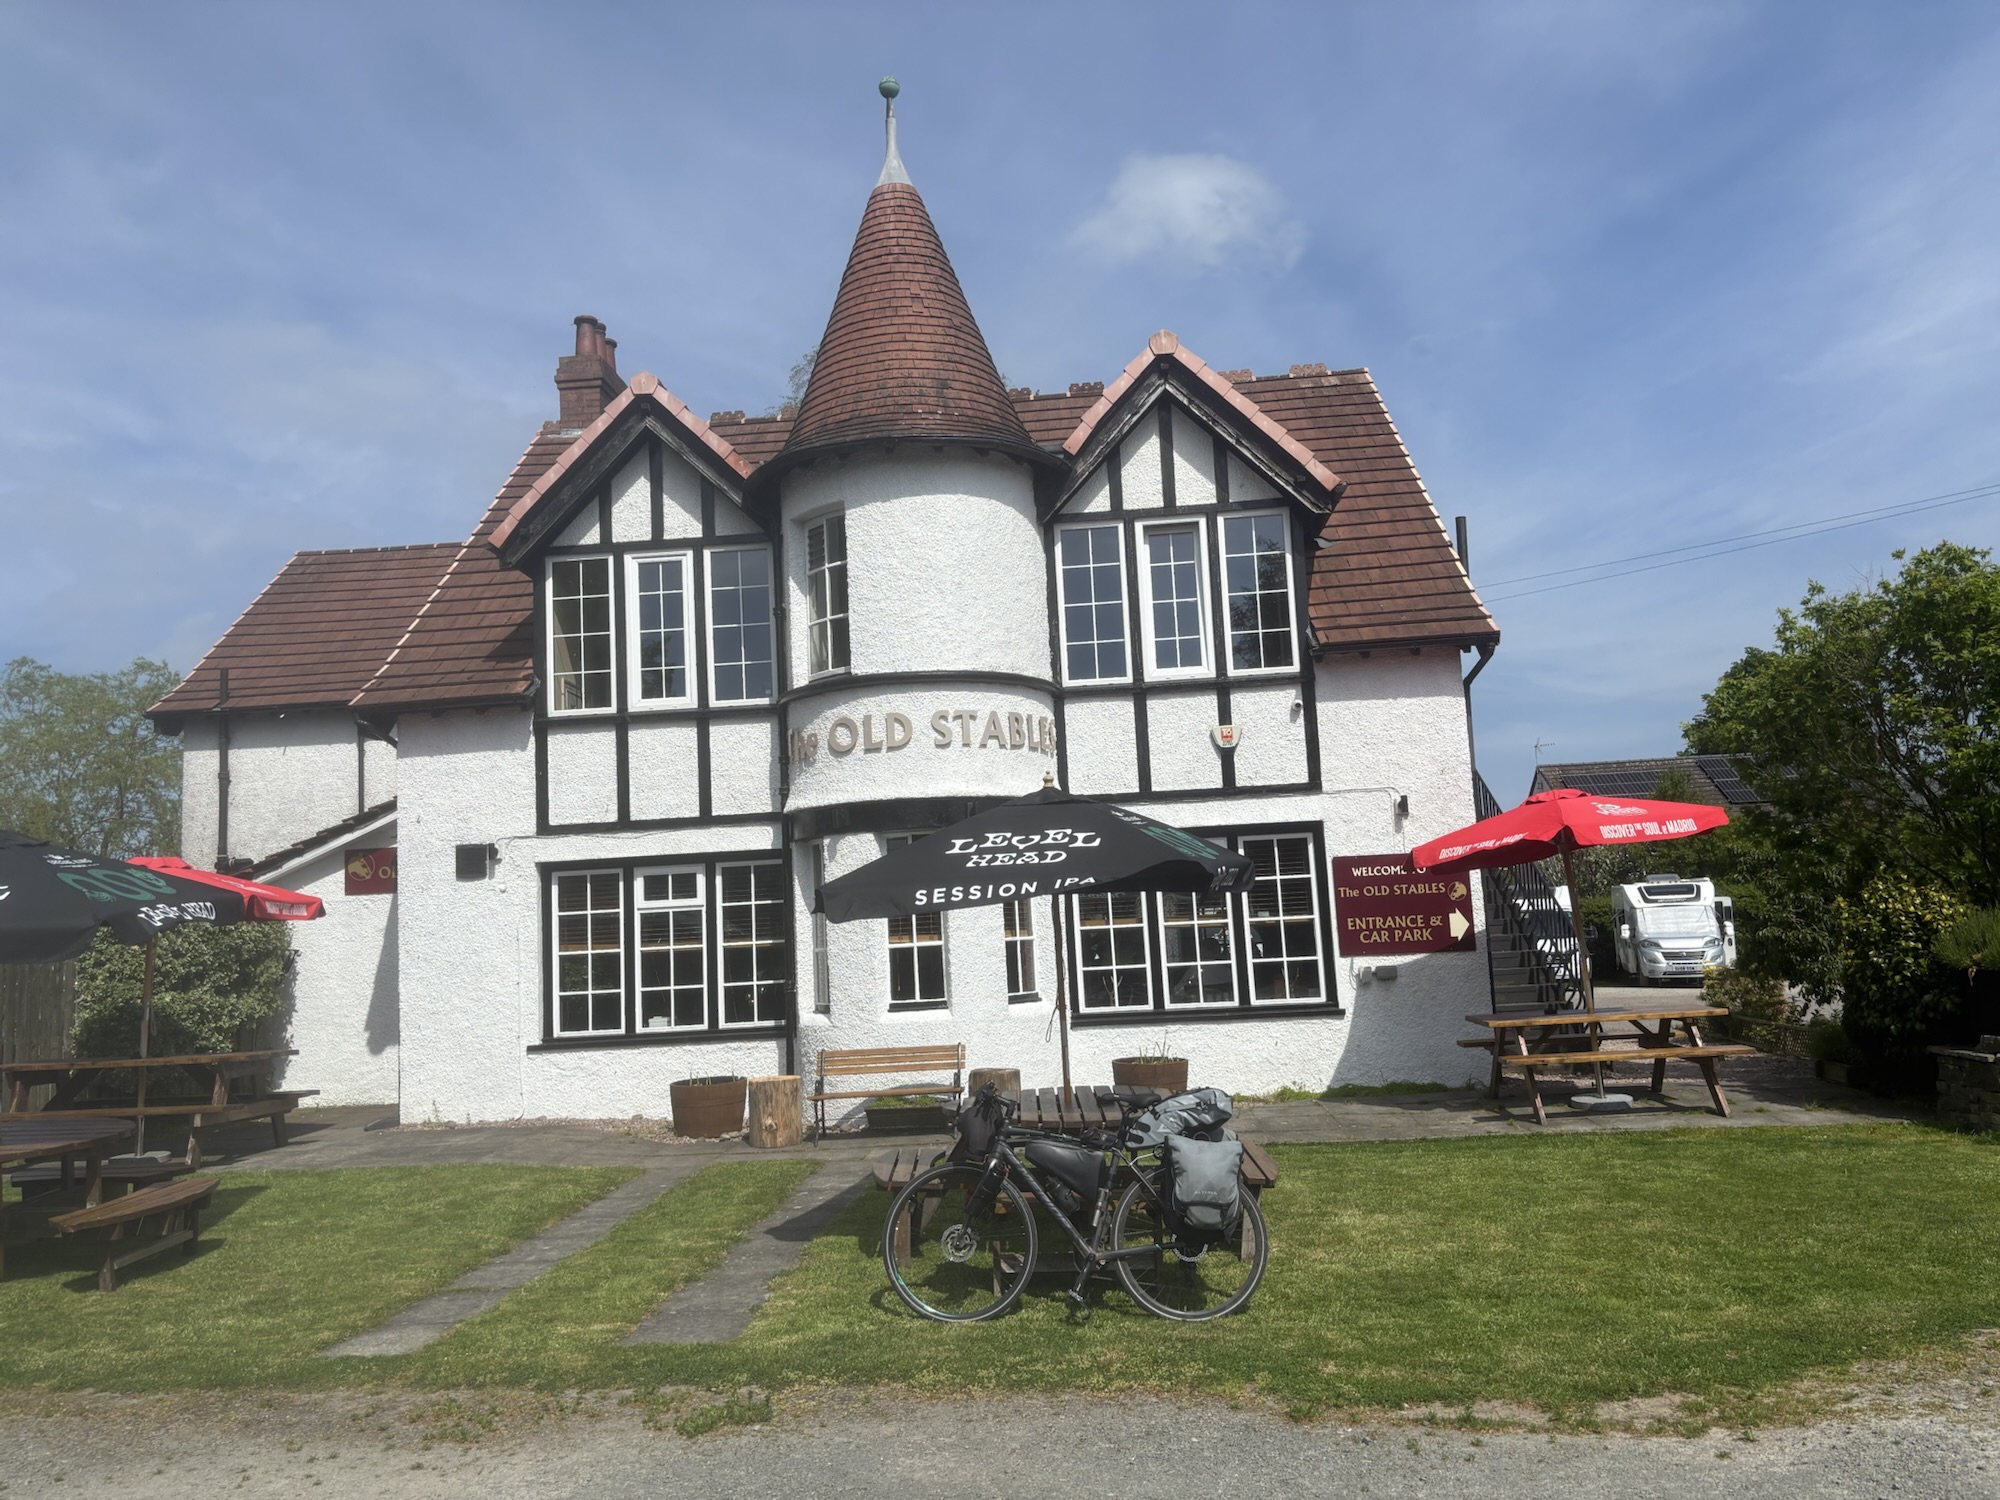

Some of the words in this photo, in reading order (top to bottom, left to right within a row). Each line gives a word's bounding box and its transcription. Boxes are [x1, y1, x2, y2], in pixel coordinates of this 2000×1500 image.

[829, 712, 913, 753] OLD
[930, 709, 1056, 752] STABLES
[1599, 823, 1637, 839] DISCOVER
[1642, 821, 1663, 836] SOUL
[1666, 818, 1698, 834] MADRID
[945, 828, 1101, 854] LEVEL
[966, 850, 1067, 867] HEAD
[915, 881, 1037, 905] SESSION
[1054, 876, 1096, 890] IPA
[1338, 887, 1360, 898] The
[1363, 885, 1390, 897] OLD
[1393, 882, 1446, 895] STABLES
[186, 902, 216, 920] HEAD
[1347, 915, 1425, 930] ENTRANCE
[1430, 915, 1443, 926] &
[1360, 931, 1390, 943] CAR
[1394, 928, 1433, 942] PARK
